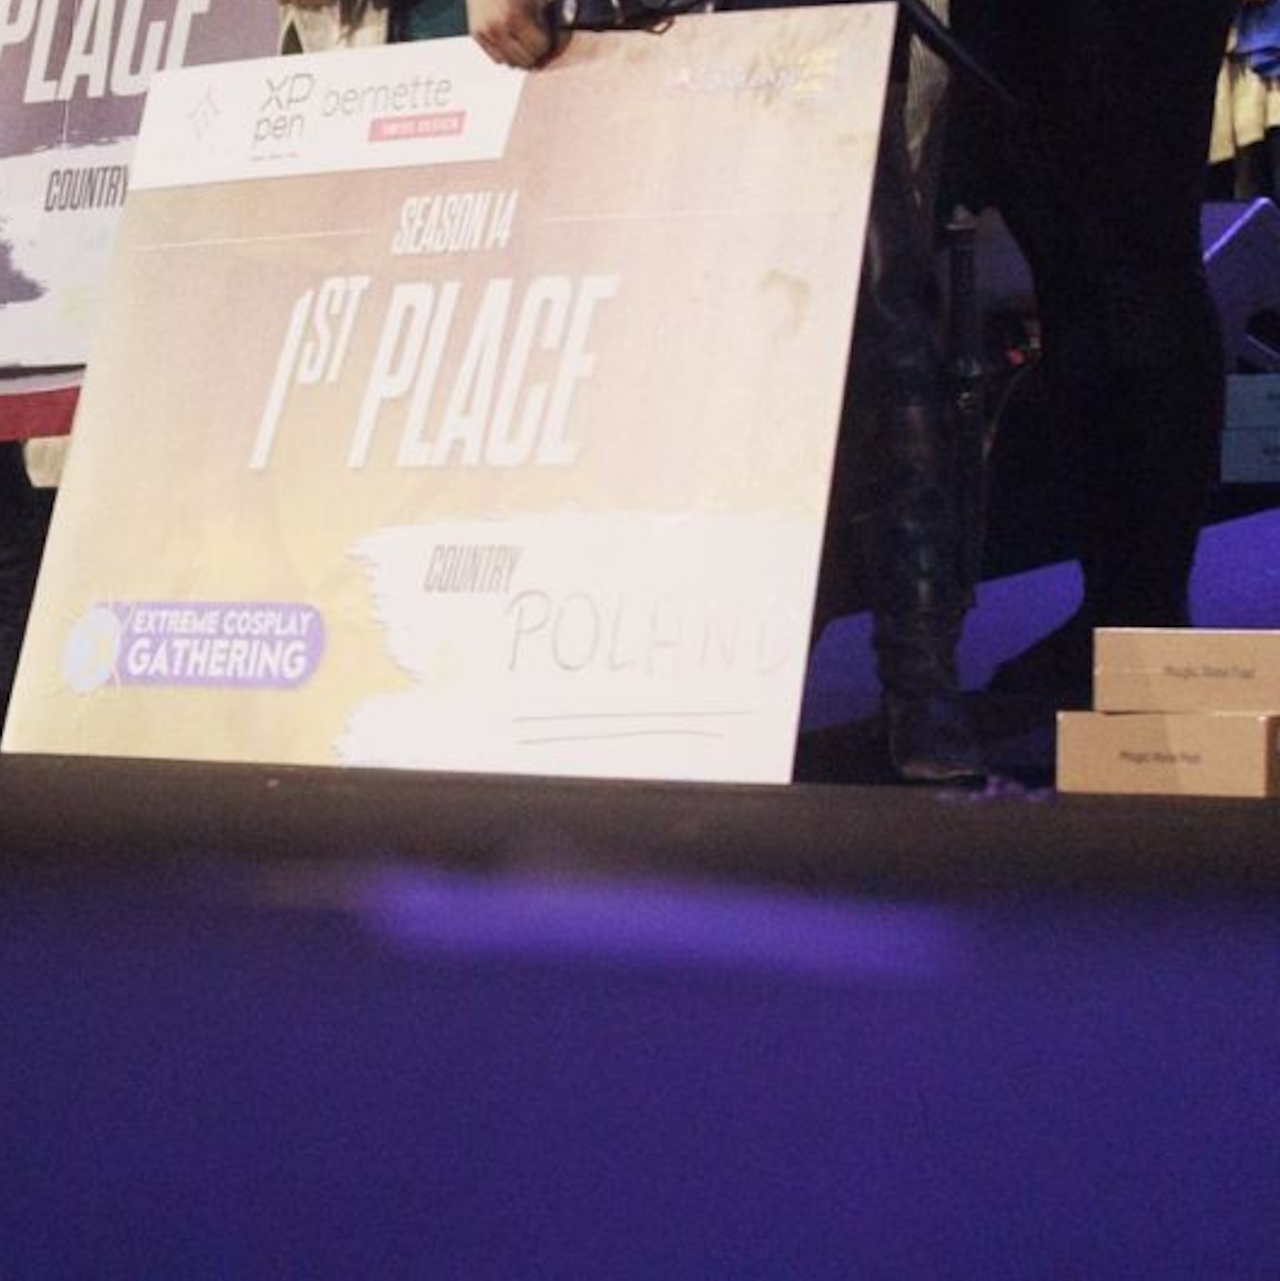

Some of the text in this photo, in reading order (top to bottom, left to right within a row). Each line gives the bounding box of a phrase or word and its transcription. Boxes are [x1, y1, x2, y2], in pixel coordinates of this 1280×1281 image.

[260, 72, 317, 111] XP
[252, 111, 306, 150] pen
[43, 162, 129, 211] COUNTRY
[391, 187, 520, 256] SEASON 14
[249, 273, 620, 471] 1ST PLACE
[424, 543, 525, 593] COUNTRY
[132, 607, 314, 636] EXTREME COSPLAY
[504, 588, 794, 677] POLAND
[126, 637, 308, 680] GATHERING
